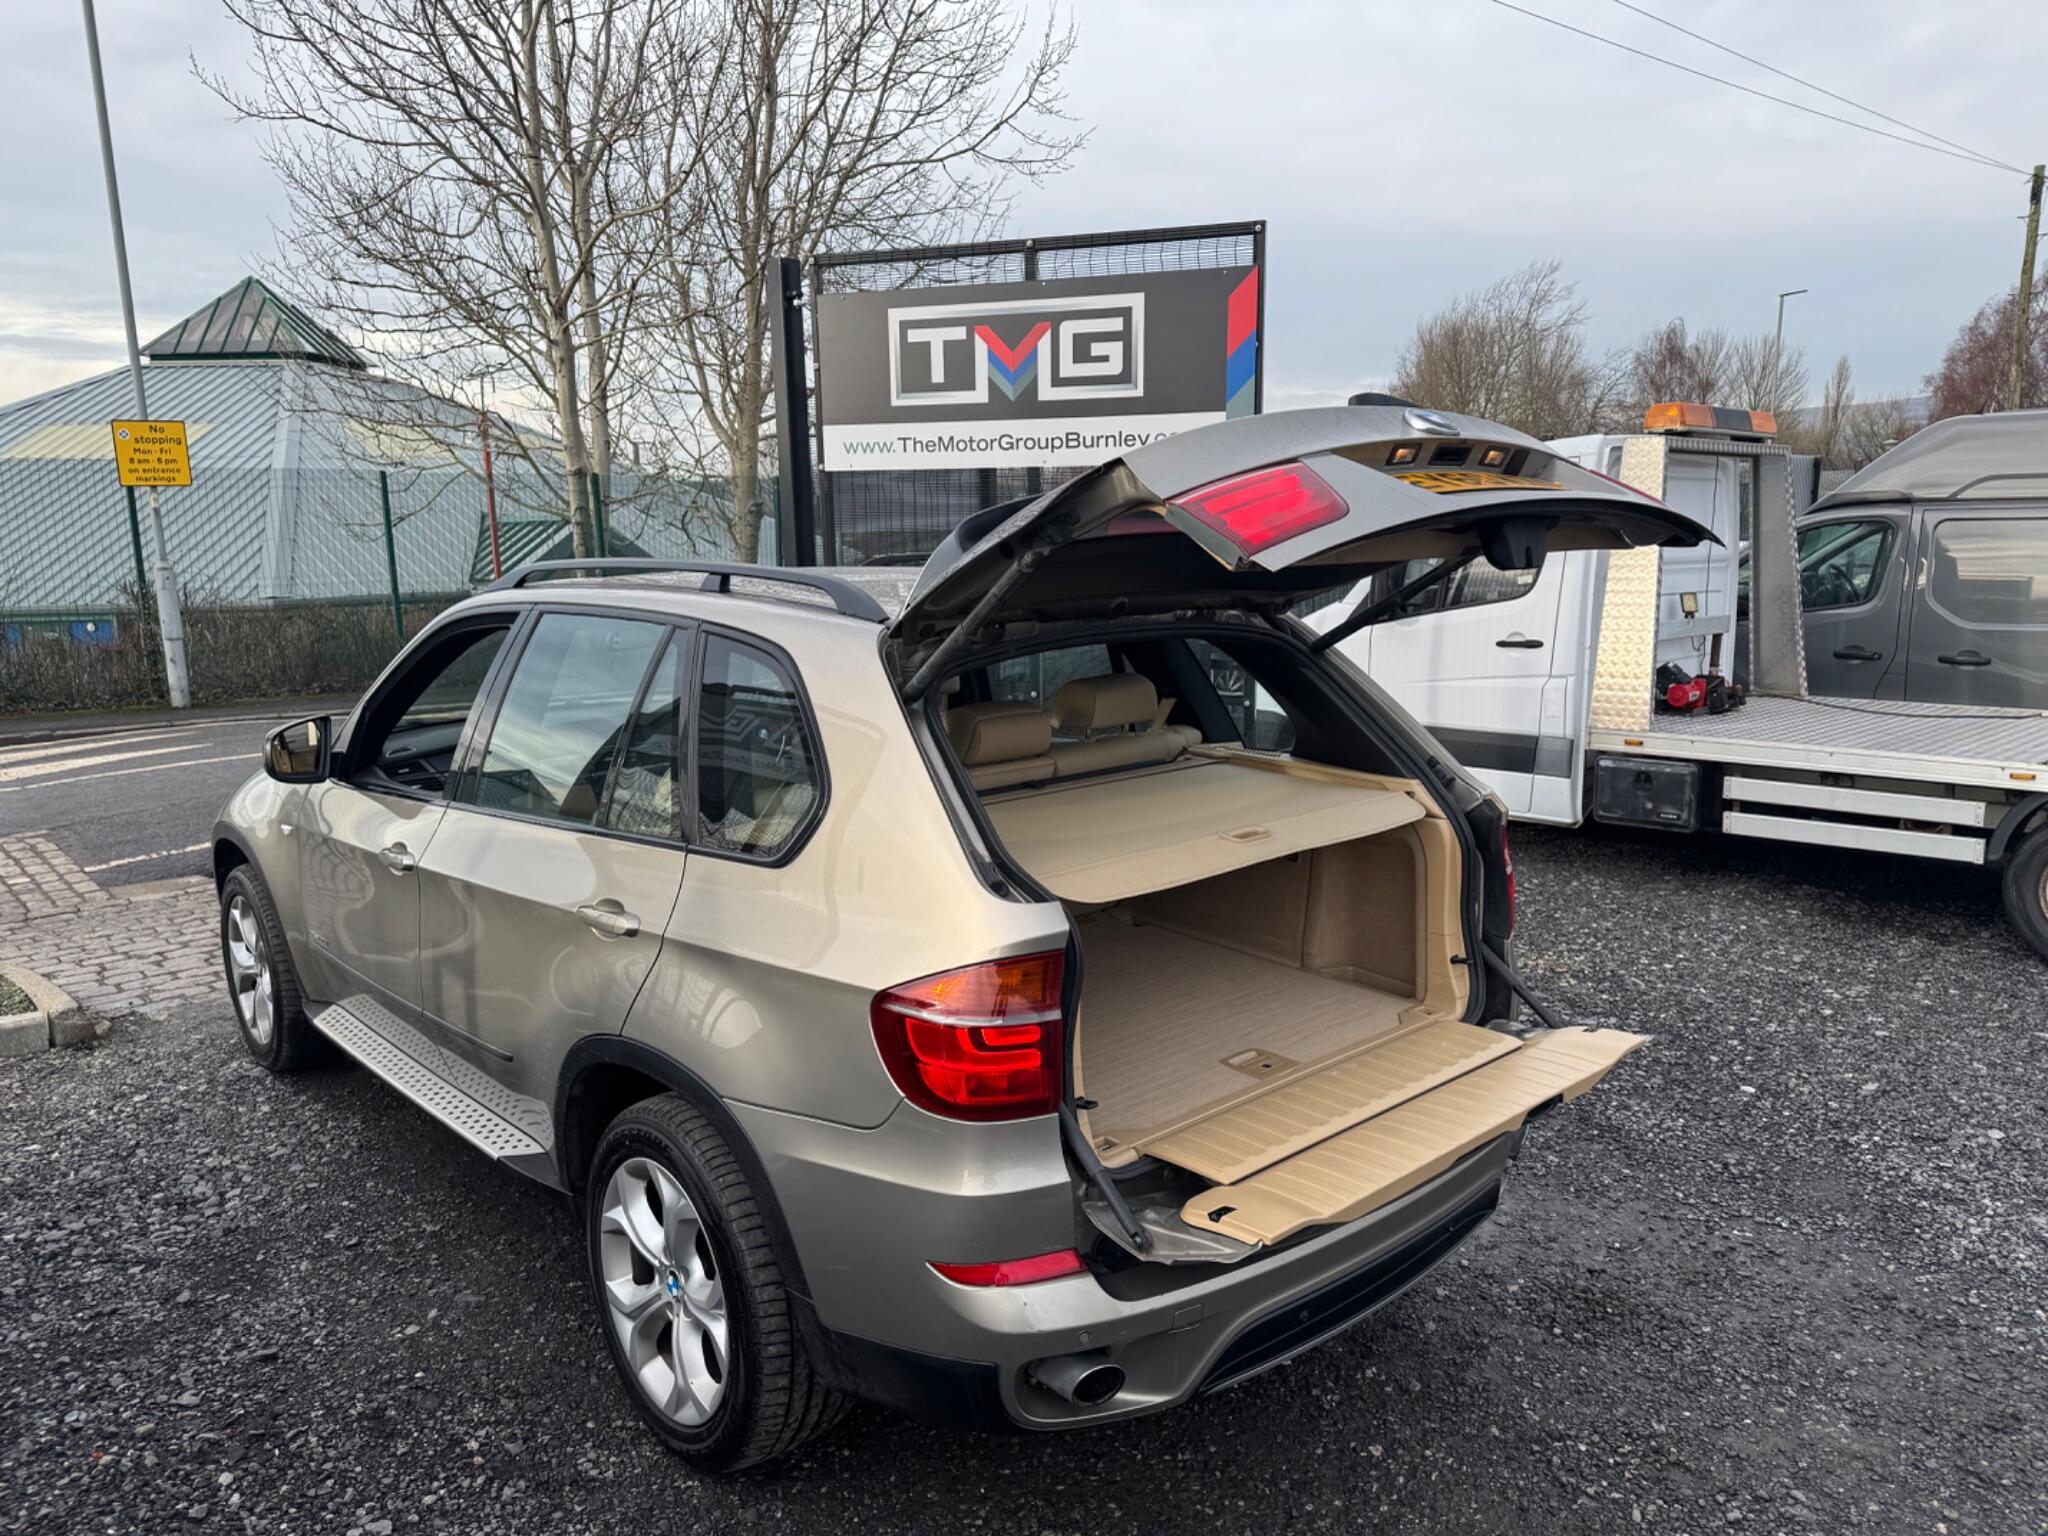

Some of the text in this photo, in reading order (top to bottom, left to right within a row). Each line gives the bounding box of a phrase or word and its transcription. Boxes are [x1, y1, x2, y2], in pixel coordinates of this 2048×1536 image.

[907, 315, 1124, 402] TMG
[149, 425, 165, 433] No
[134, 436, 182, 445] stopping
[843, 429, 1179, 454] www.TheMotorGroupBurnleyc
[133, 447, 153, 455] Mon
[160, 447, 172, 455] Fri
[136, 475, 177, 483] markings
